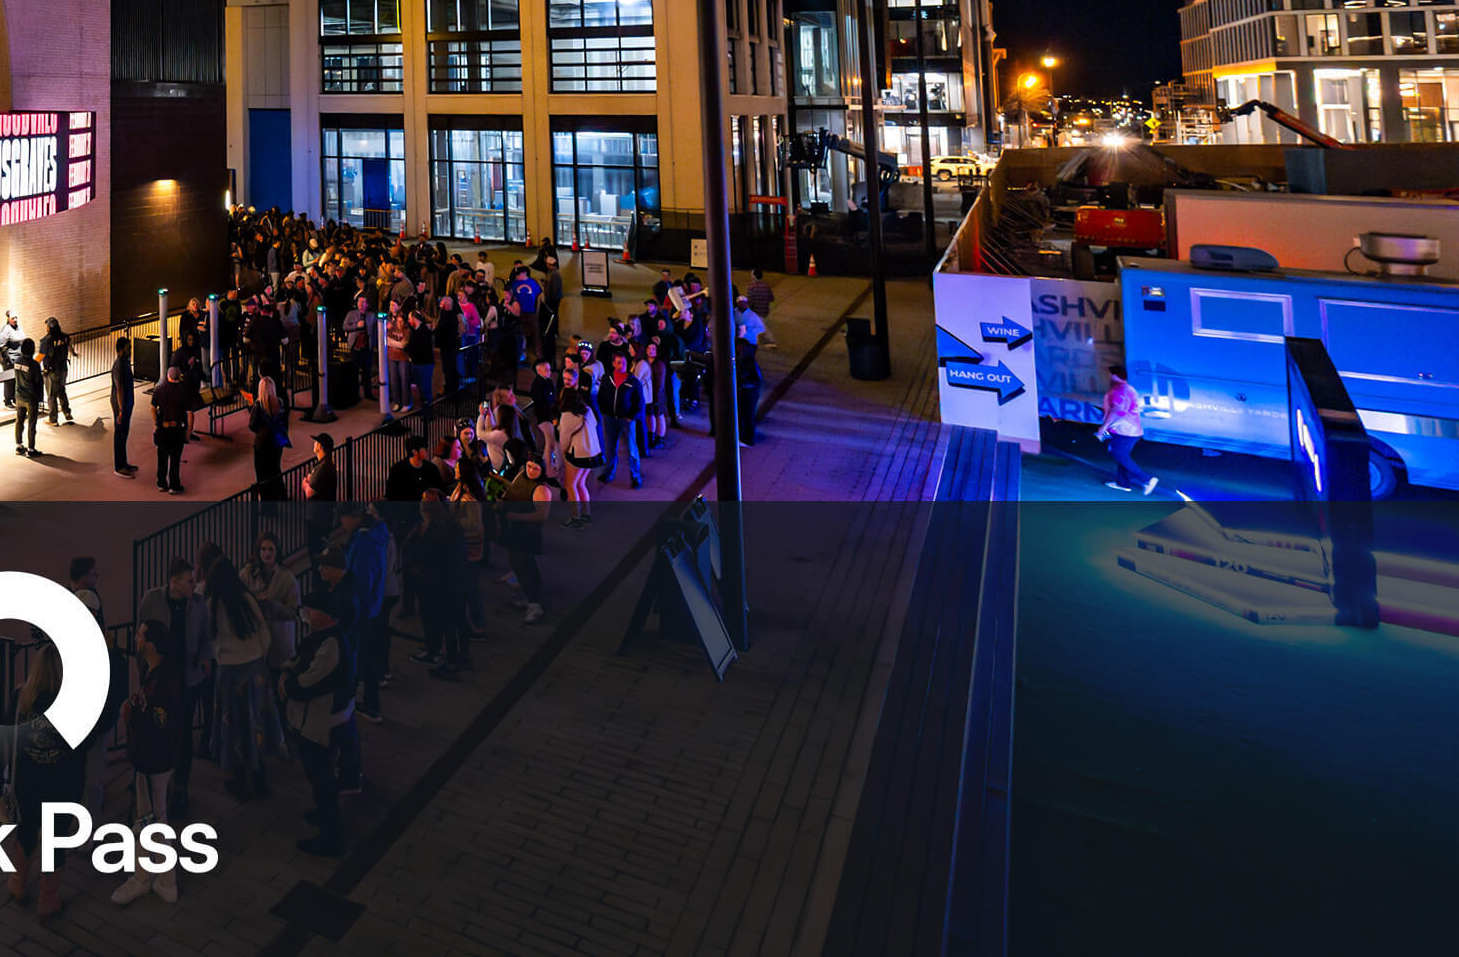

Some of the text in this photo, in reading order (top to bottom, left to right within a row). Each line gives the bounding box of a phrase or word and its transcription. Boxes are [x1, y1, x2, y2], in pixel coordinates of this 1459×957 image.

[987, 326, 1020, 337] WINE
[949, 368, 1013, 384] HANG OUT
